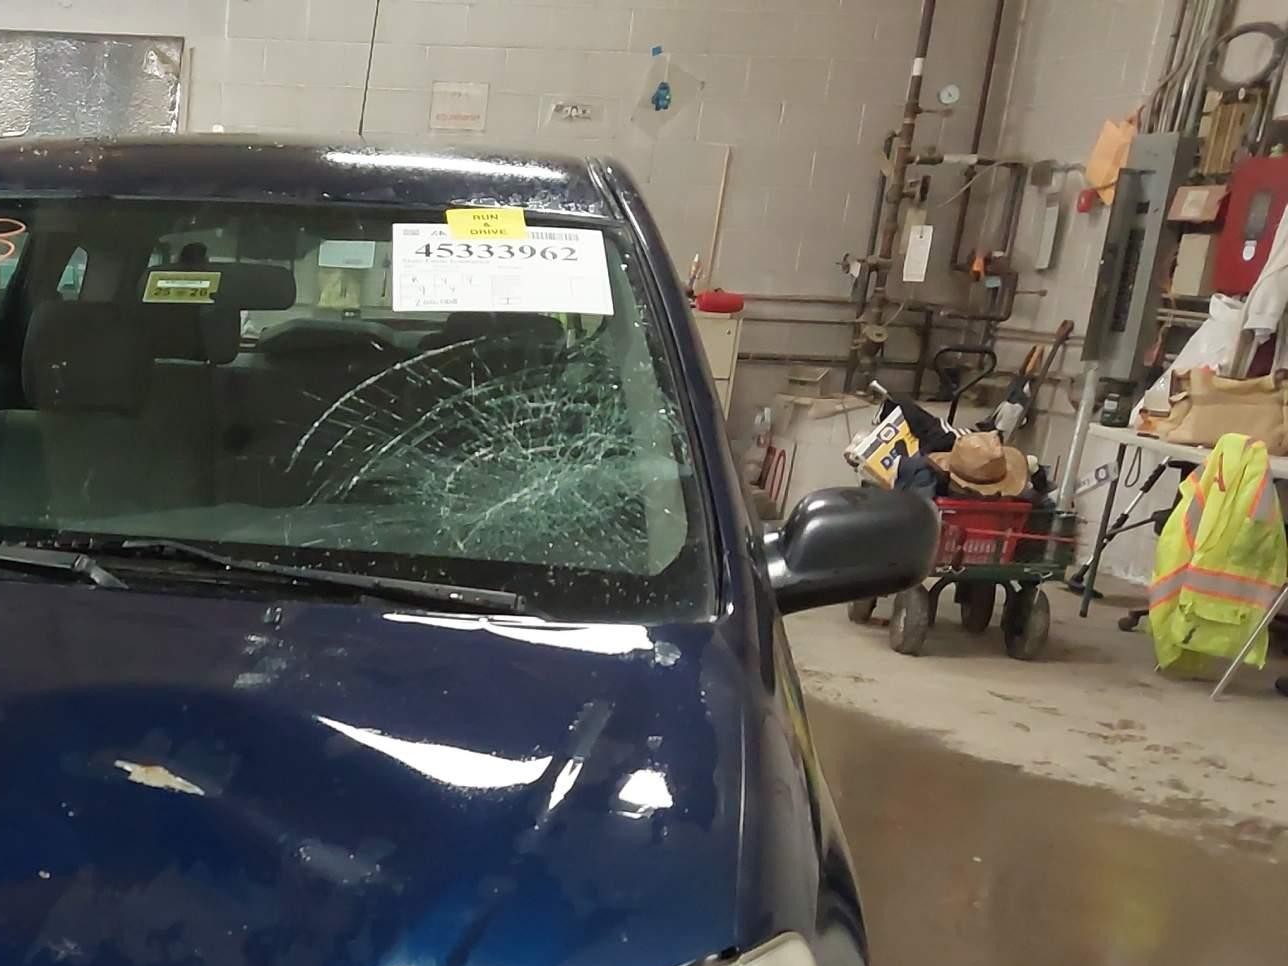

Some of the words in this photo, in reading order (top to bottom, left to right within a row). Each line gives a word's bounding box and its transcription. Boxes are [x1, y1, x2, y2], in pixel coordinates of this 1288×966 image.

[472, 213, 500, 221] RUN
[469, 228, 508, 236] DRIVE
[414, 242, 579, 262] 45333962
